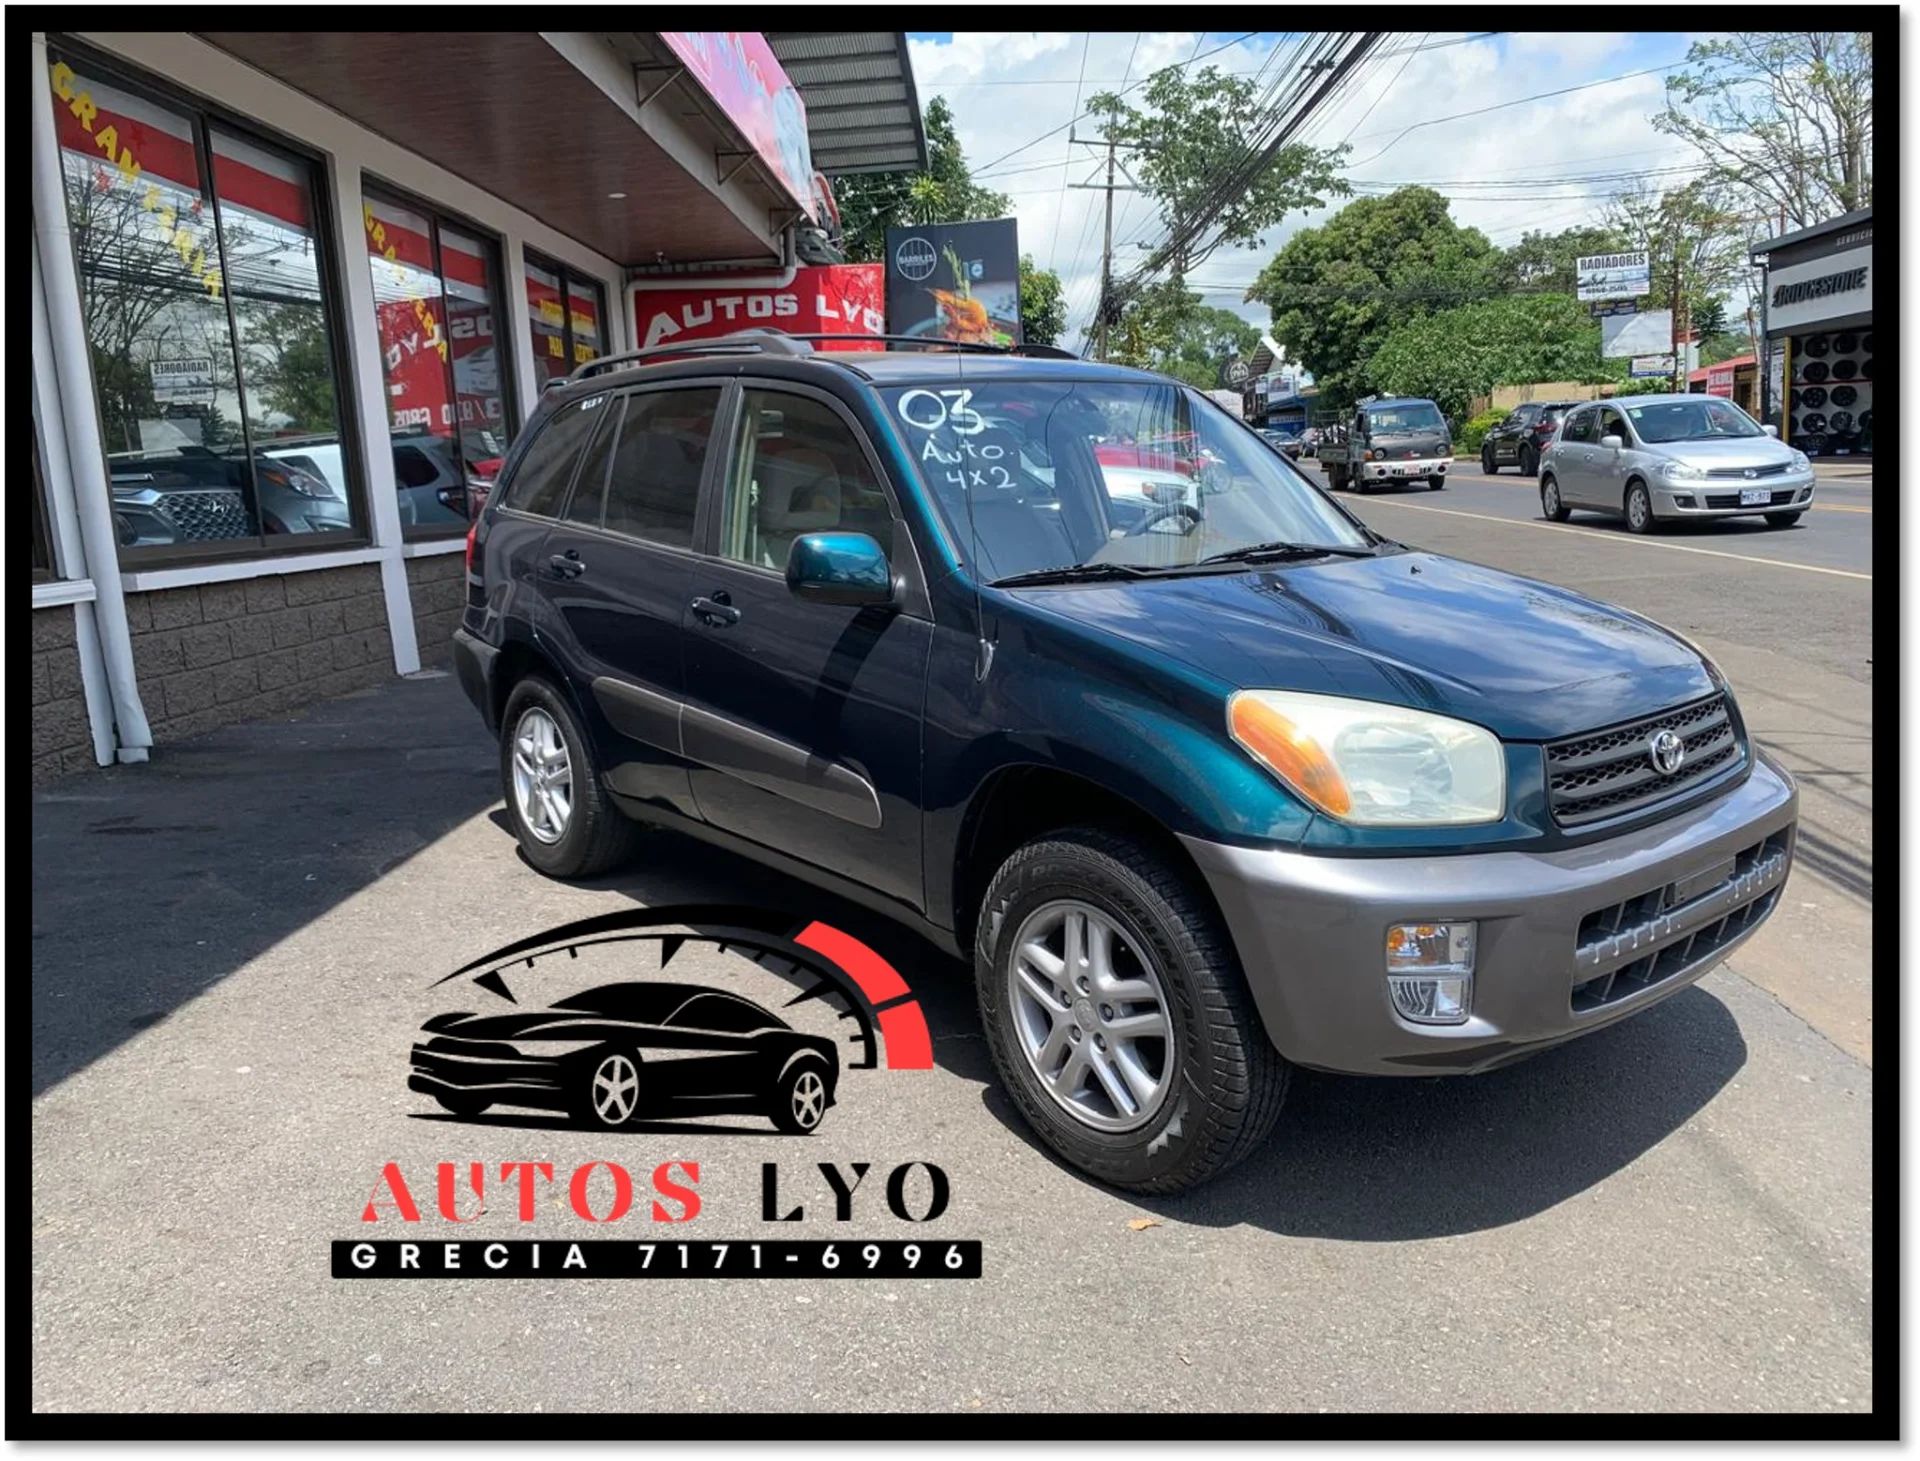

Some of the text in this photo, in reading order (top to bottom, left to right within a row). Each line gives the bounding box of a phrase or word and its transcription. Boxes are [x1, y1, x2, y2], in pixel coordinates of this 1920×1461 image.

[51, 61, 141, 184] GRAN
[1580, 253, 1646, 271] RADIADORES
[1772, 266, 1869, 308] BRIDGESTONE
[643, 294, 799, 349] AUTOS
[816, 294, 884, 335] LYO
[898, 389, 985, 435] 03
